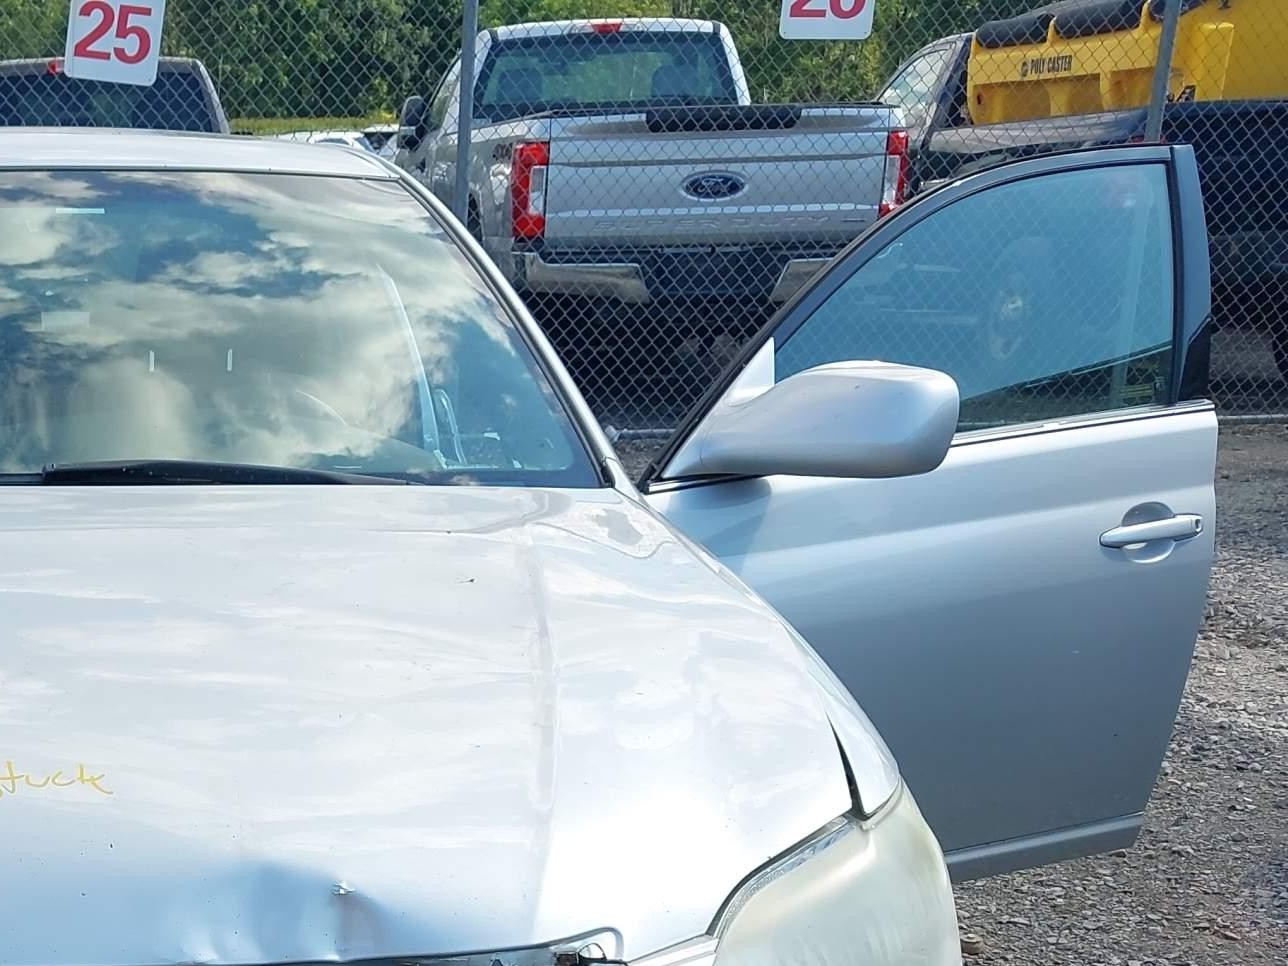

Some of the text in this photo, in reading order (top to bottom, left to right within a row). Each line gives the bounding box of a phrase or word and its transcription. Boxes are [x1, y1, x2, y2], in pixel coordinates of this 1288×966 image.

[73, 1, 152, 65] 25
[1030, 54, 1073, 75] POLY CASTER
